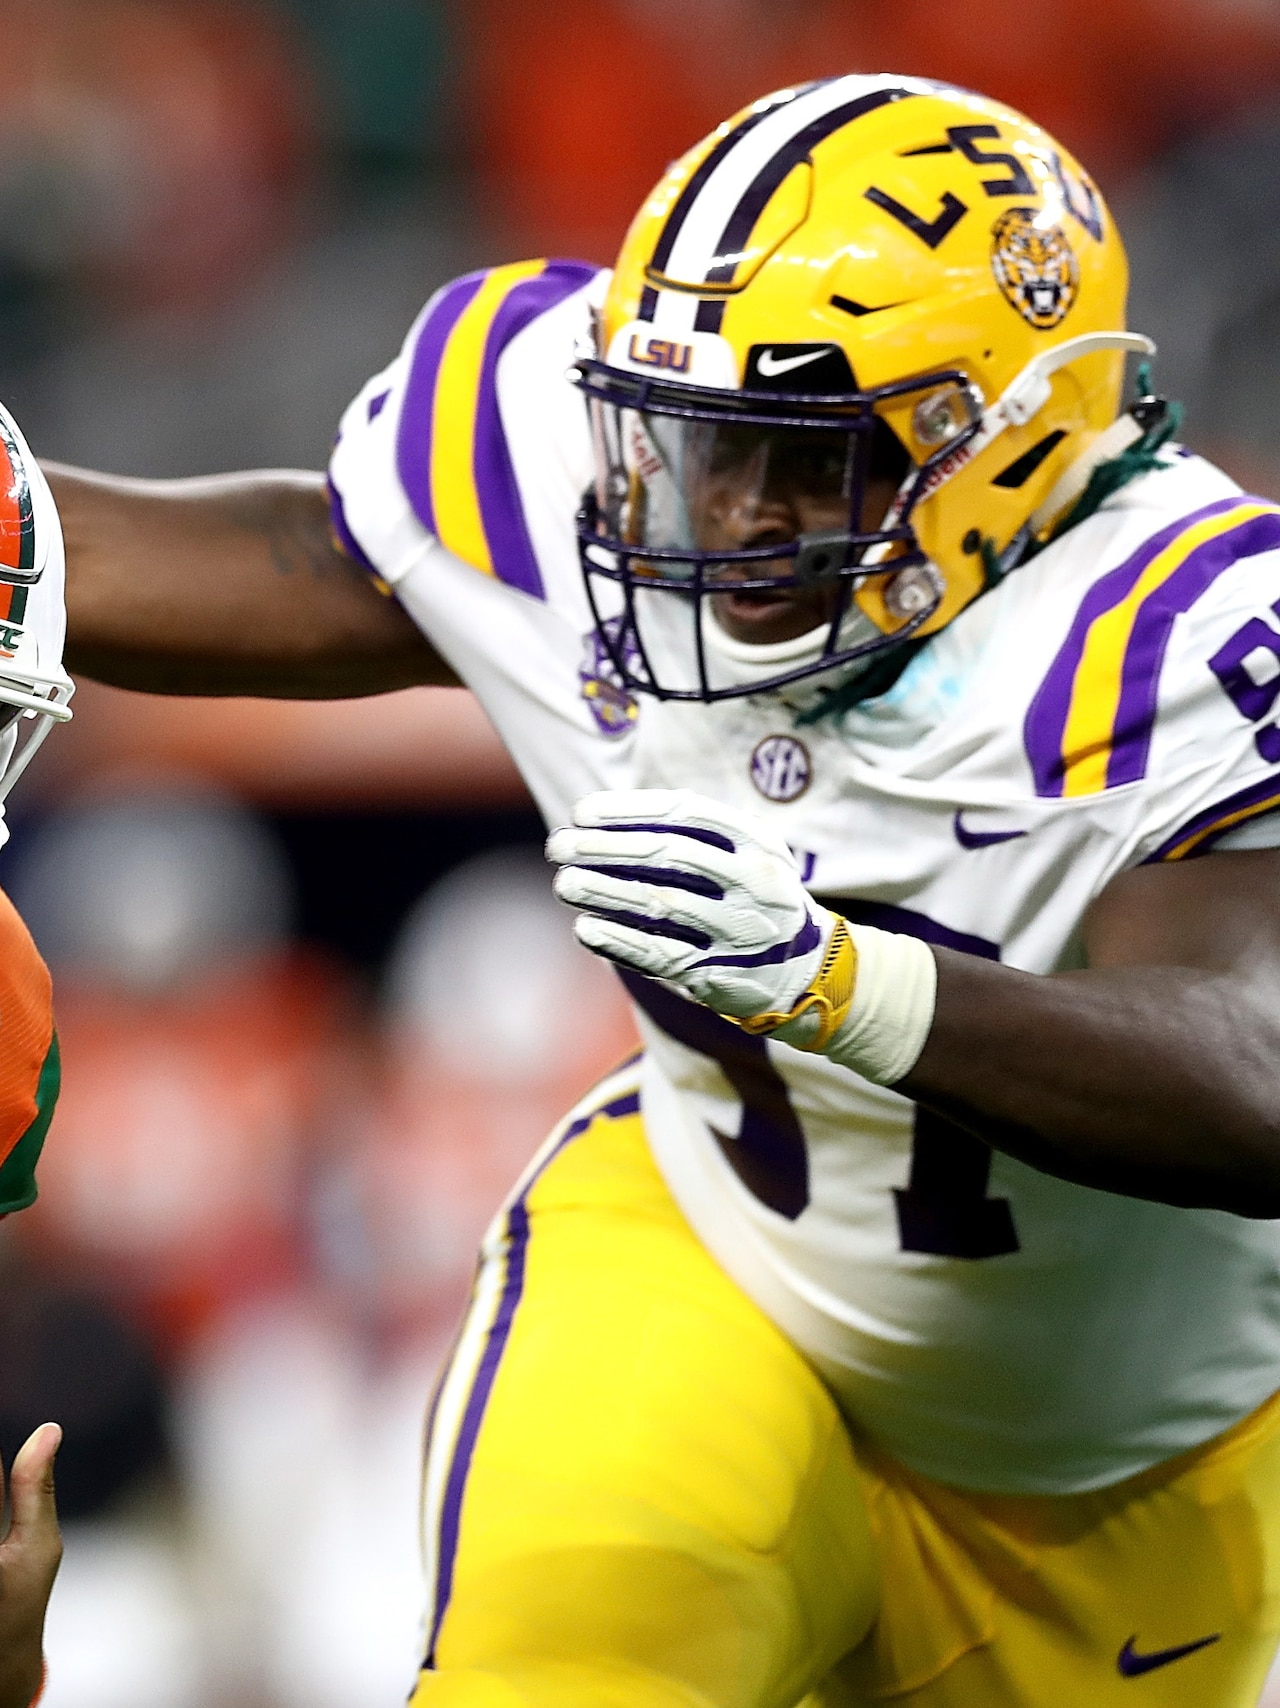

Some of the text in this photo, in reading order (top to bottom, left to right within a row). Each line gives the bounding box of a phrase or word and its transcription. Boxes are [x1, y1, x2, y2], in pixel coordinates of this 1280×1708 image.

[863, 124, 1104, 249] LSU
[629, 333, 693, 374] LSU
[753, 738, 810, 801] SEC
